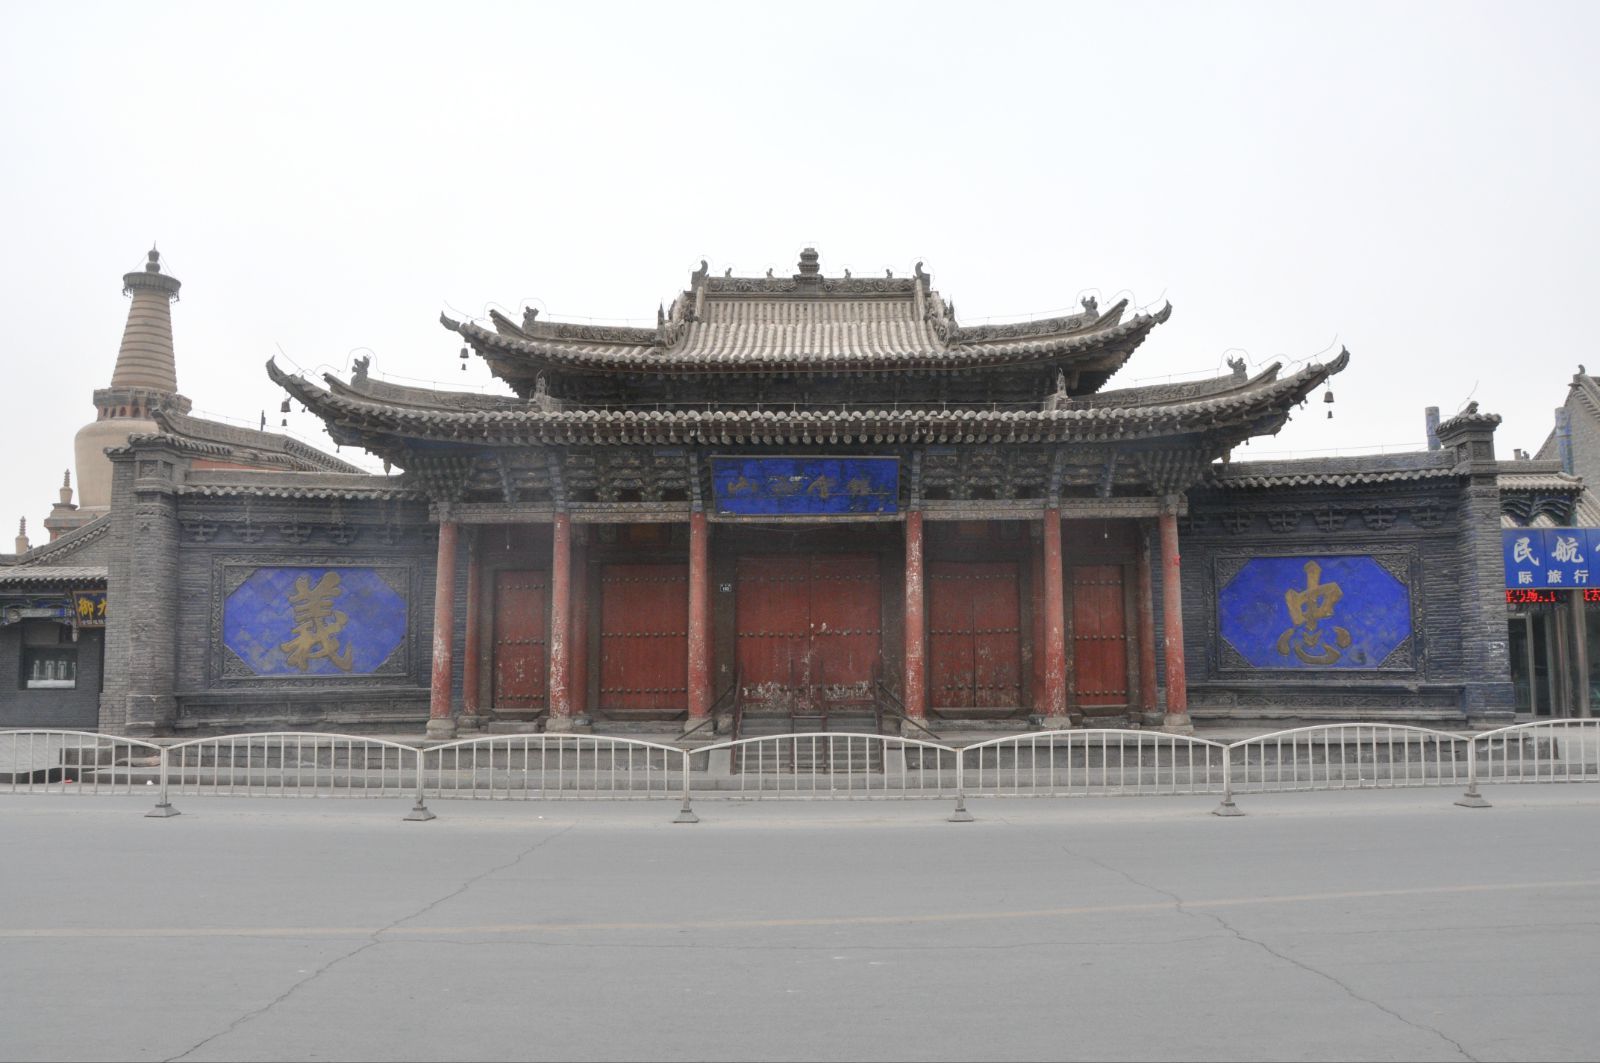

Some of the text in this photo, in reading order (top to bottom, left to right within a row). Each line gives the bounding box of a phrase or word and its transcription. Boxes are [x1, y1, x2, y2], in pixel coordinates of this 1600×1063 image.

[1513, 535, 1600, 567] 民航
[1518, 569, 1589, 584] 际旅行
[1276, 559, 1353, 665] 忠
